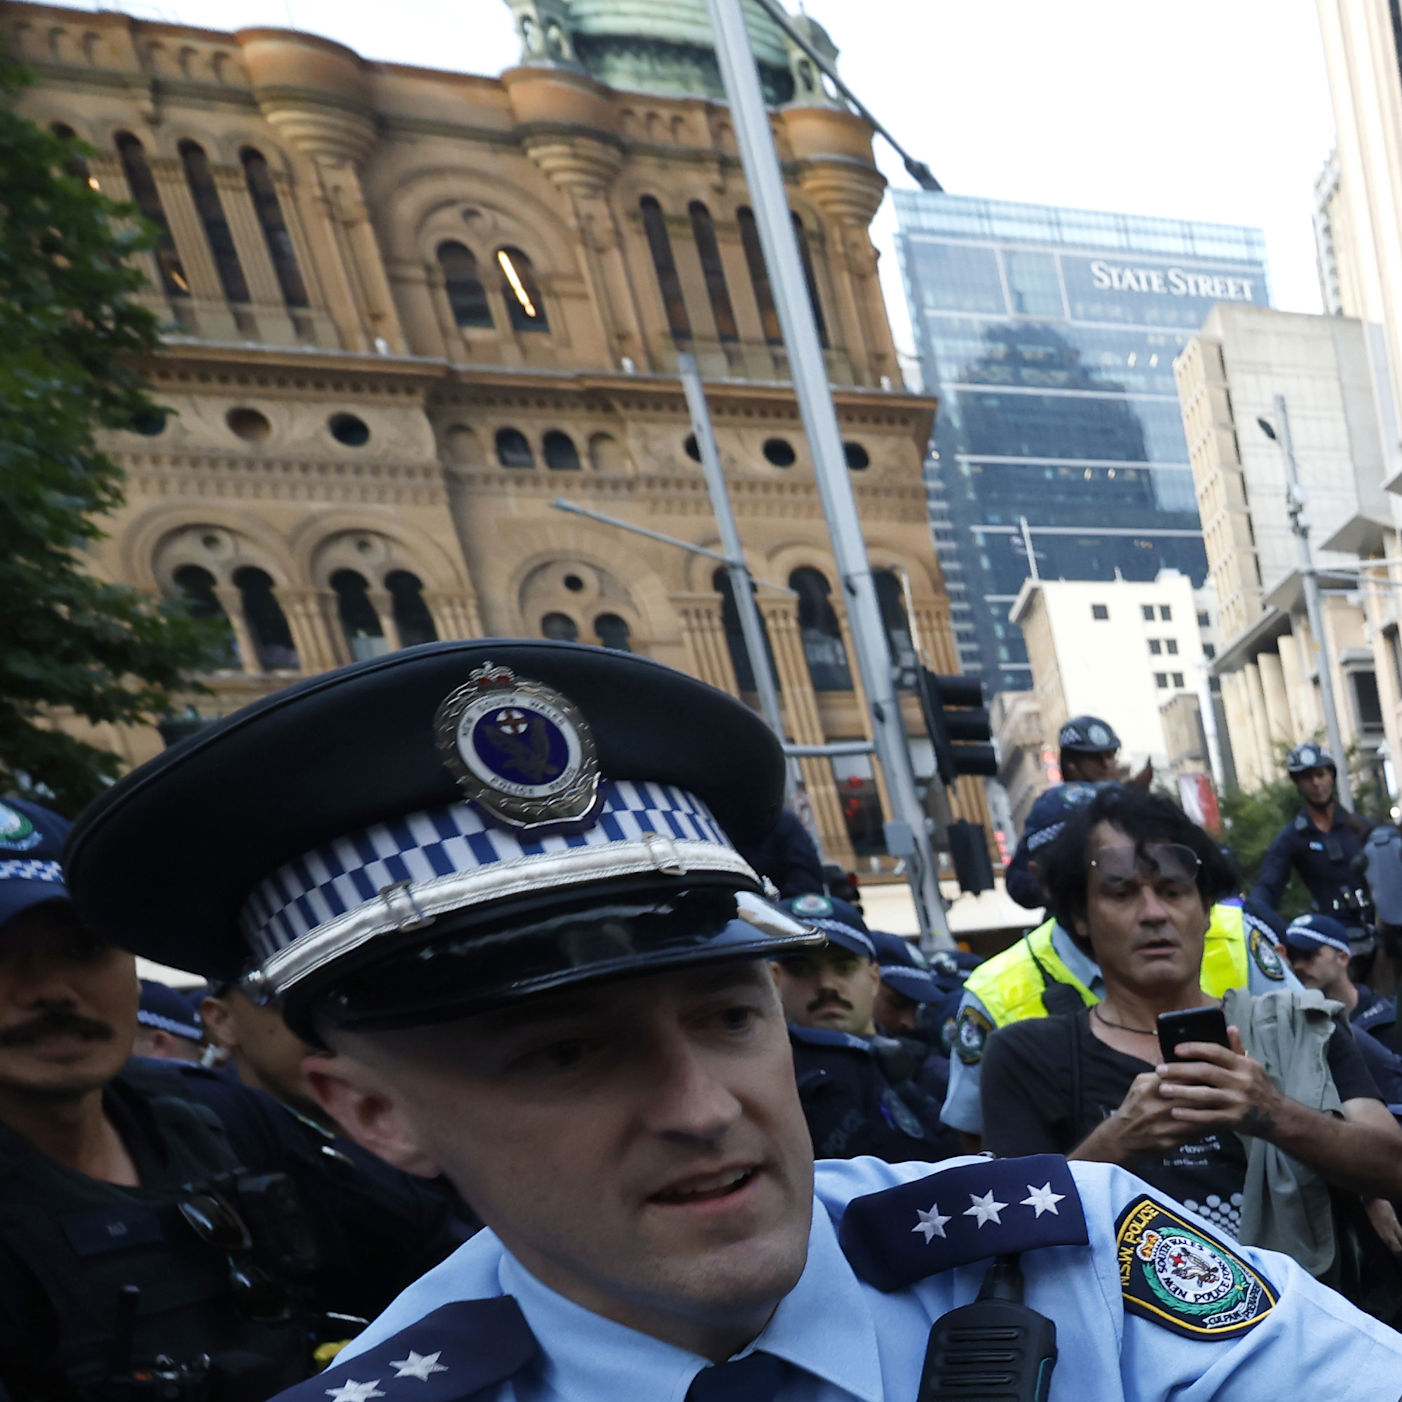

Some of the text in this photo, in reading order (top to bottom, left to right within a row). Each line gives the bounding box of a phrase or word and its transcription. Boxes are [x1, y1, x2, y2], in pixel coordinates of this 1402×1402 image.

[1090, 260, 1257, 302] STATE STREET
[1124, 1205, 1161, 1246] POLICE
[1162, 1277, 1189, 1300] NEW
[1193, 1279, 1231, 1303] POLICE
